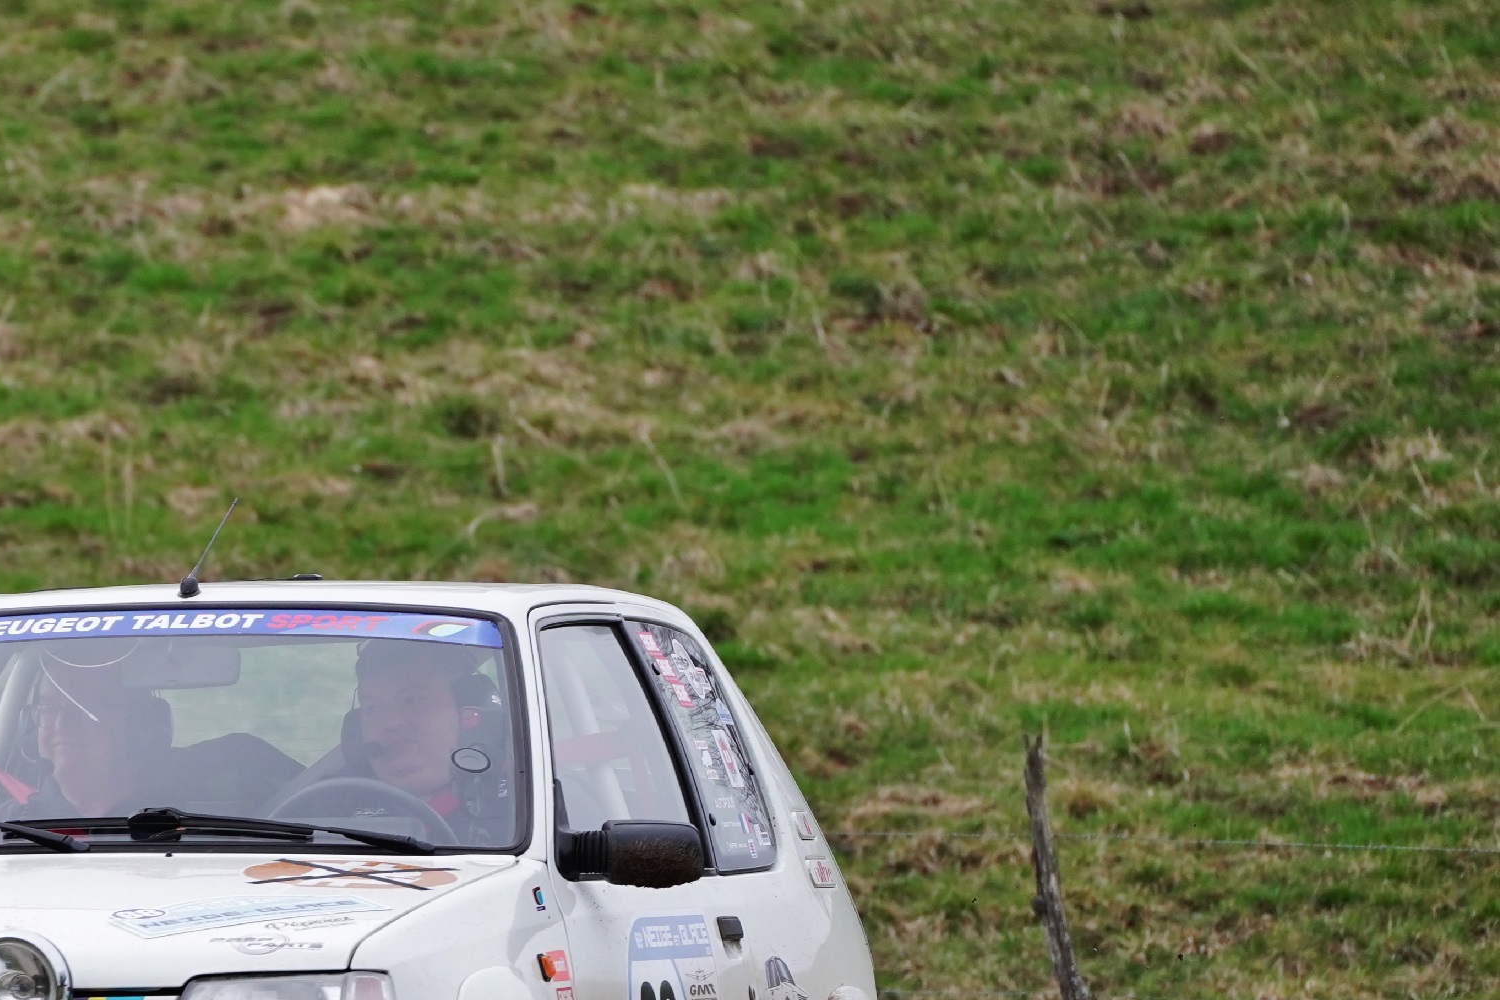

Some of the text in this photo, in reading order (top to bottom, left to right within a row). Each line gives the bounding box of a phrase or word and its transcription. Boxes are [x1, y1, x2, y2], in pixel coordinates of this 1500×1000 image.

[131, 613, 265, 630] TALBOT
[265, 614, 389, 631] SPORT
[642, 925, 674, 948] NEIGE
[678, 923, 710, 945] GLACE
[689, 983, 716, 996] GMT
